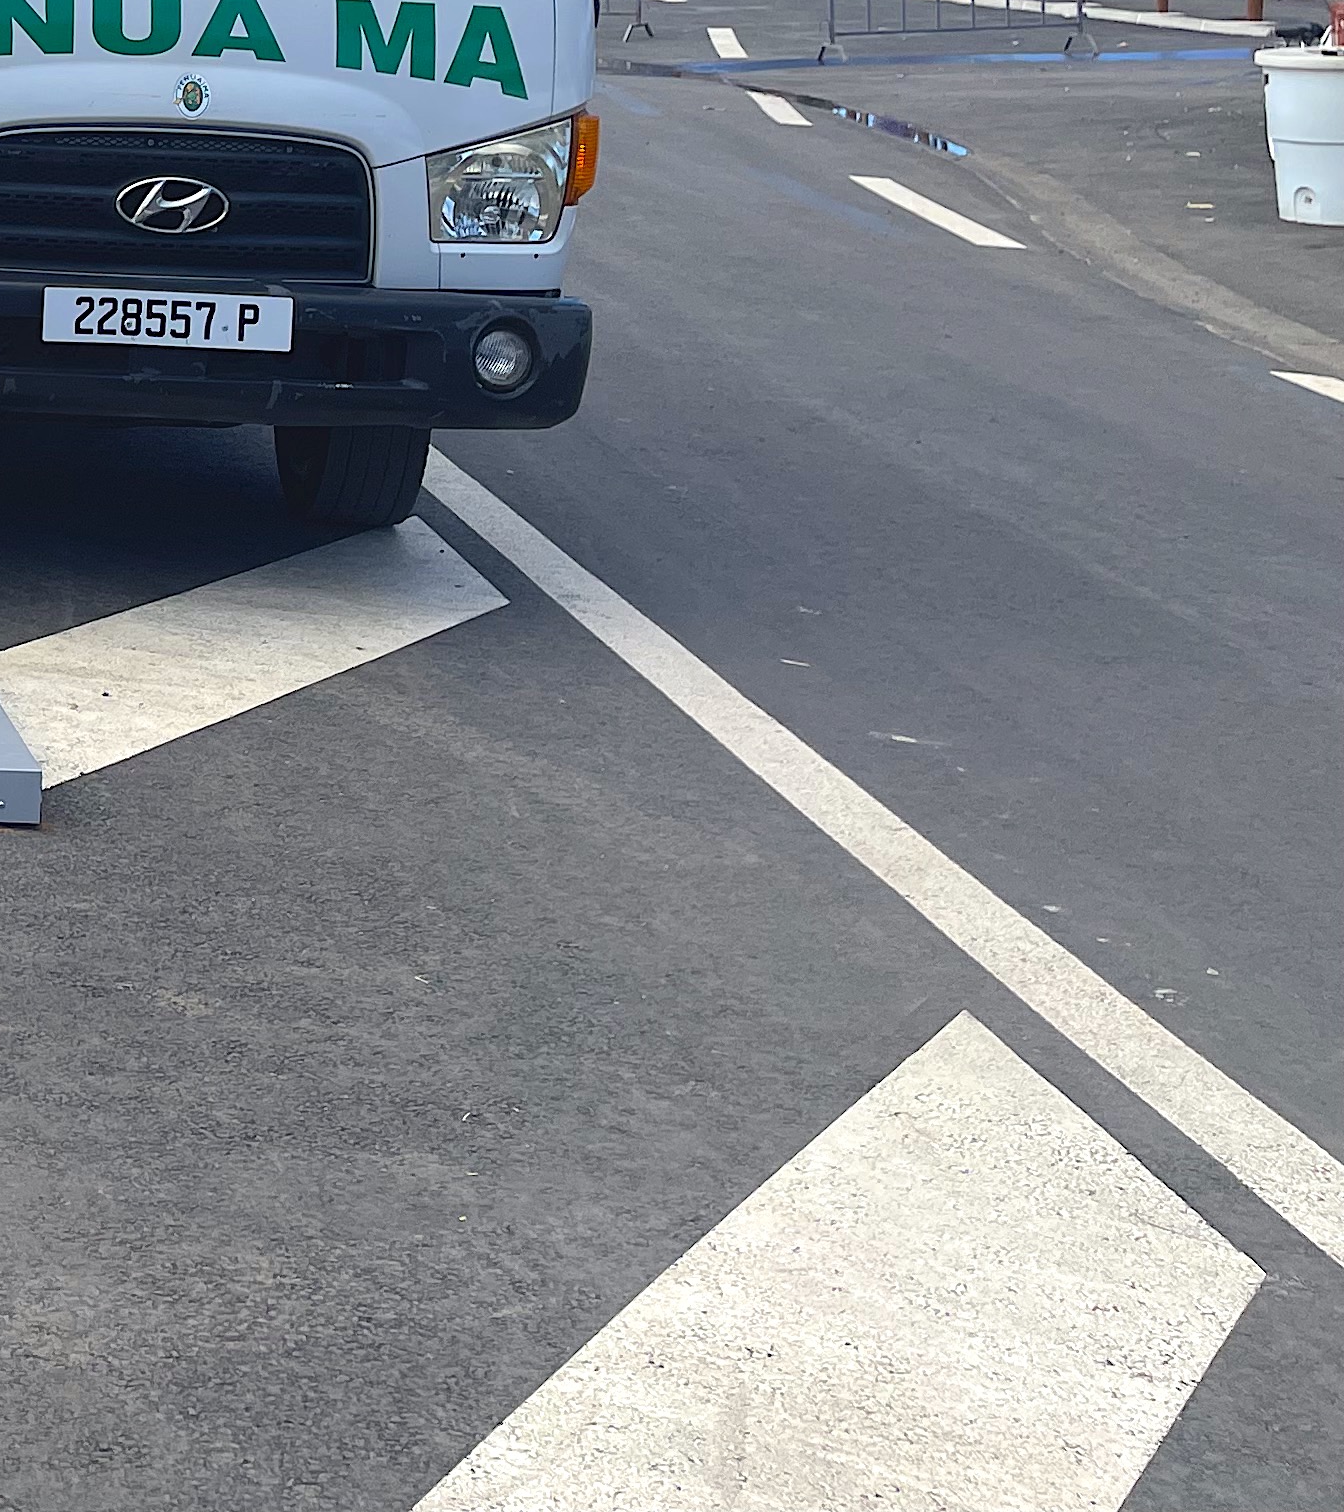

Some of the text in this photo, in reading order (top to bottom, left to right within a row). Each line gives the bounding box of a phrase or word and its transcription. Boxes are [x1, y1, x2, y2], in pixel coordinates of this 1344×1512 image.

[336, 0, 528, 100] MA
[74, 296, 260, 342] 228557 P
